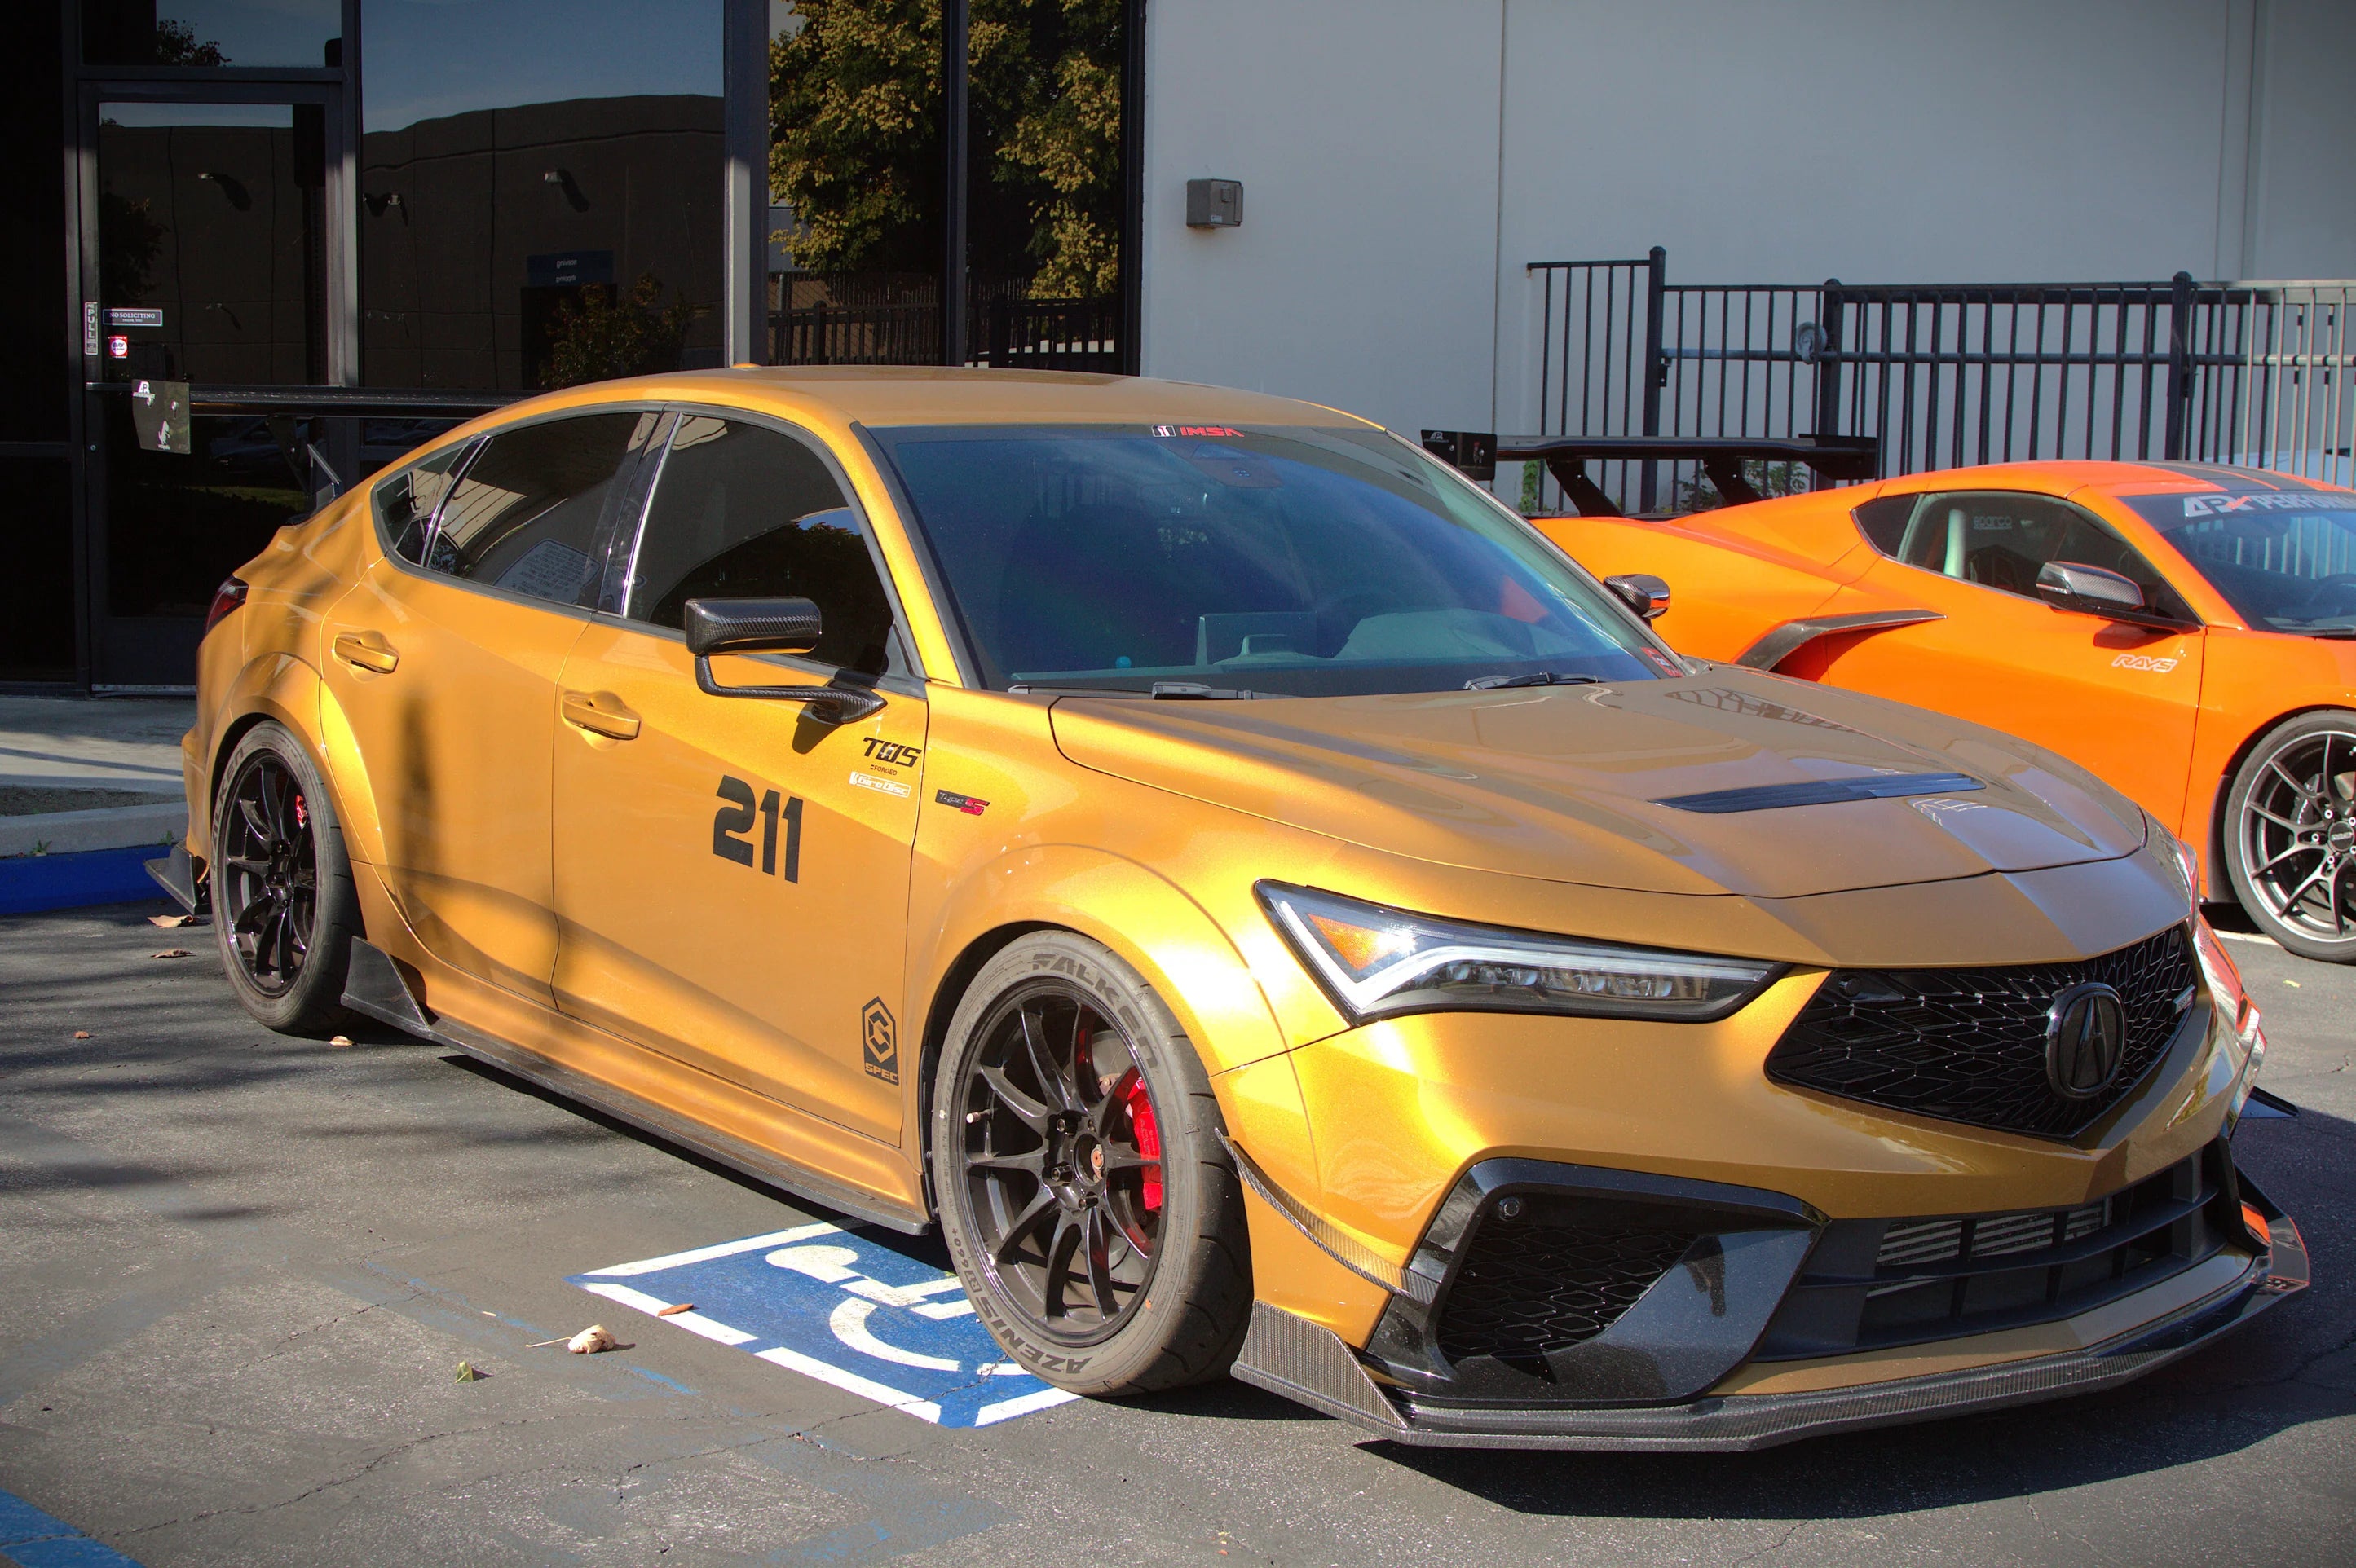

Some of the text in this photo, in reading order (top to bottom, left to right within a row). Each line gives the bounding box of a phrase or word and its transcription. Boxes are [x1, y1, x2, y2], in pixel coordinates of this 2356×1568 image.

[87, 308, 95, 338] PULL
[1180, 425, 1245, 438] IMSA
[2111, 654, 2178, 673] RAYS
[863, 737, 923, 768] TWS
[960, 798, 990, 816] S
[713, 774, 804, 885] 211
[865, 1062, 898, 1082] SPEC
[976, 1297, 1093, 1375] AZENIS
